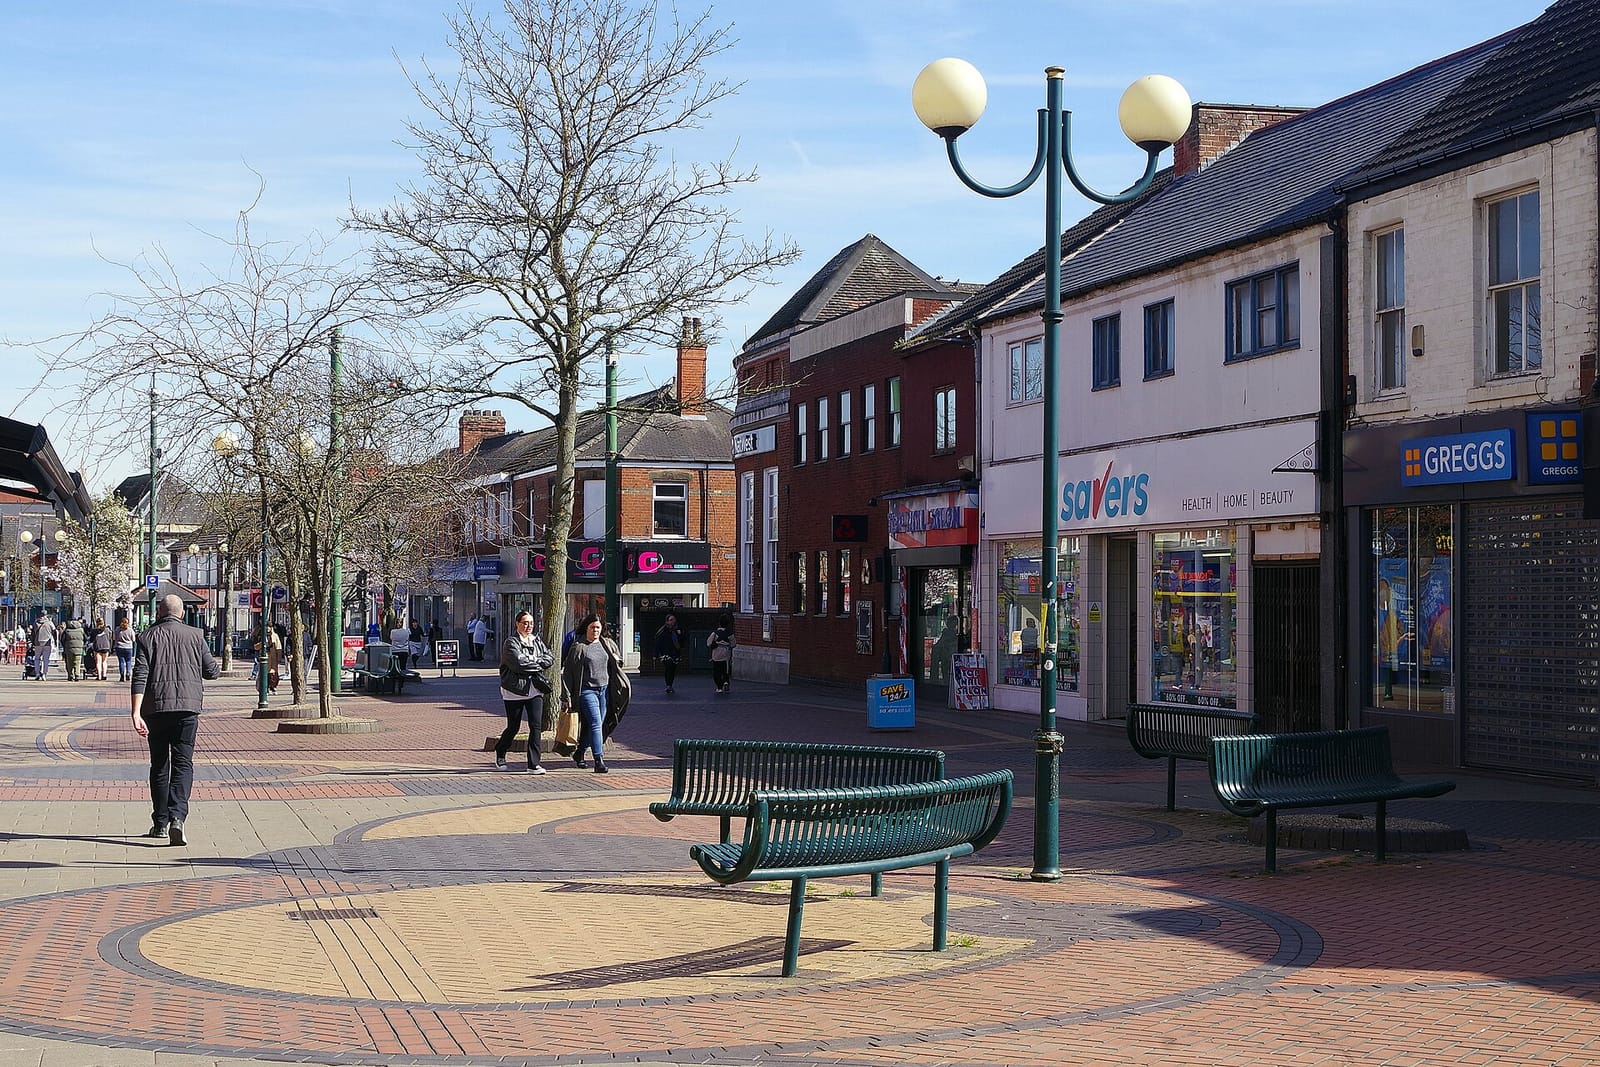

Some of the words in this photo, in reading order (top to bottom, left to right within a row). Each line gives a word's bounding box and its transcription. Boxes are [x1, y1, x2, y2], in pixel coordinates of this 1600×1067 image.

[1424, 440, 1505, 475] GREGGS
[1542, 466, 1579, 476] GREGGS
[1060, 460, 1150, 521] savers
[1182, 497, 1212, 511] HEALTH
[1223, 493, 1248, 508] HOME
[1260, 490, 1294, 505] BEAUTY
[928, 506, 961, 530] SALON
[960, 669, 978, 678] TOP
[960, 678, 982, 687] NAIL
[882, 684, 904, 695] SAVE
[956, 687, 987, 696] SALON
[889, 690, 908, 702] 24/7
